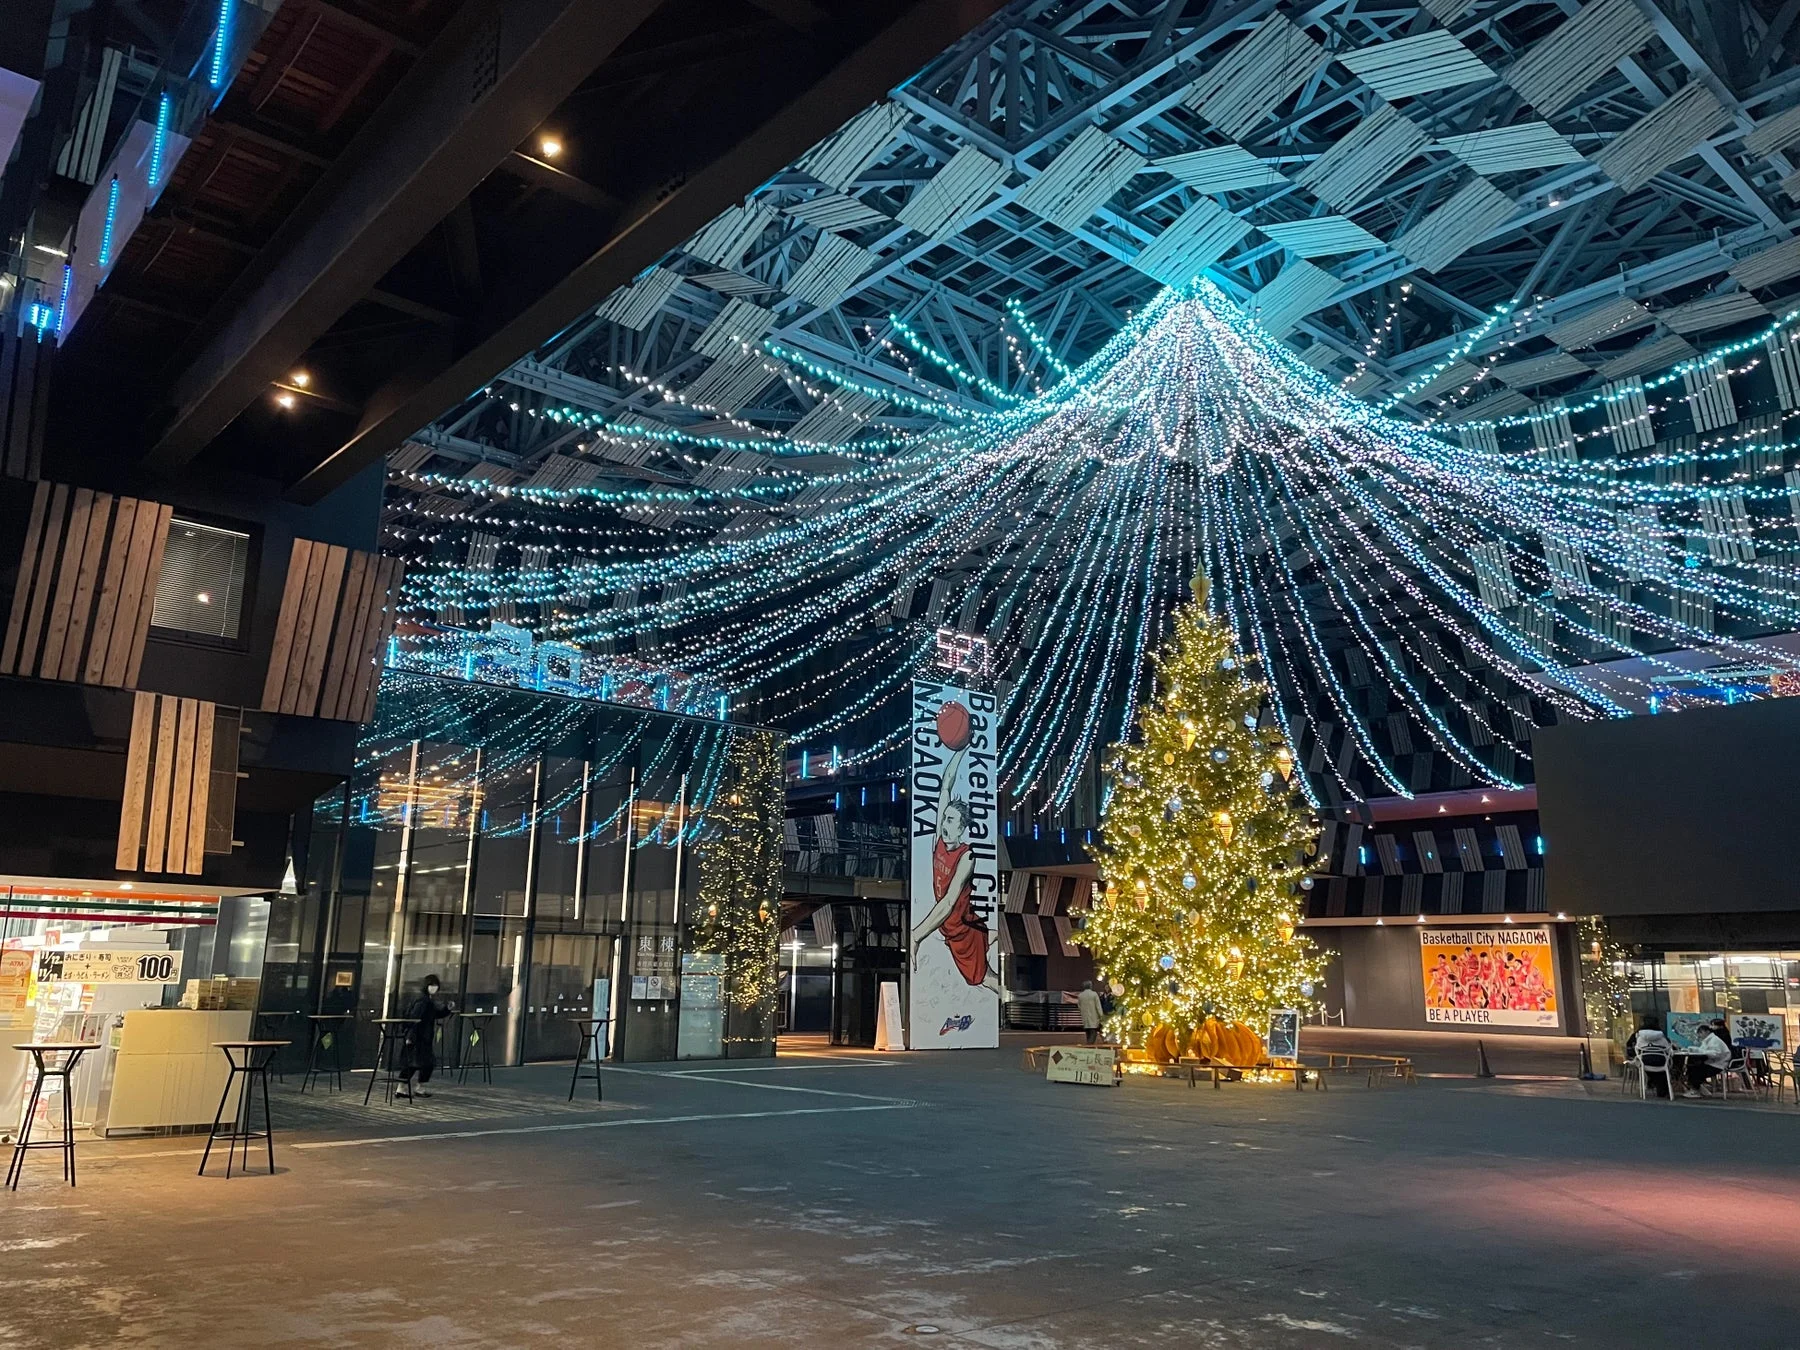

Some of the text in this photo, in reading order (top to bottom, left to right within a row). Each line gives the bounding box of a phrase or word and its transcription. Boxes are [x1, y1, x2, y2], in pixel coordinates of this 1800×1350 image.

[913, 680, 943, 838] NAGAOKA
[961, 691, 997, 933] Basketball City
[1422, 931, 1549, 948] Basketball City NAGAOKA
[1429, 1008, 1493, 1023] BE A PLAYER.
